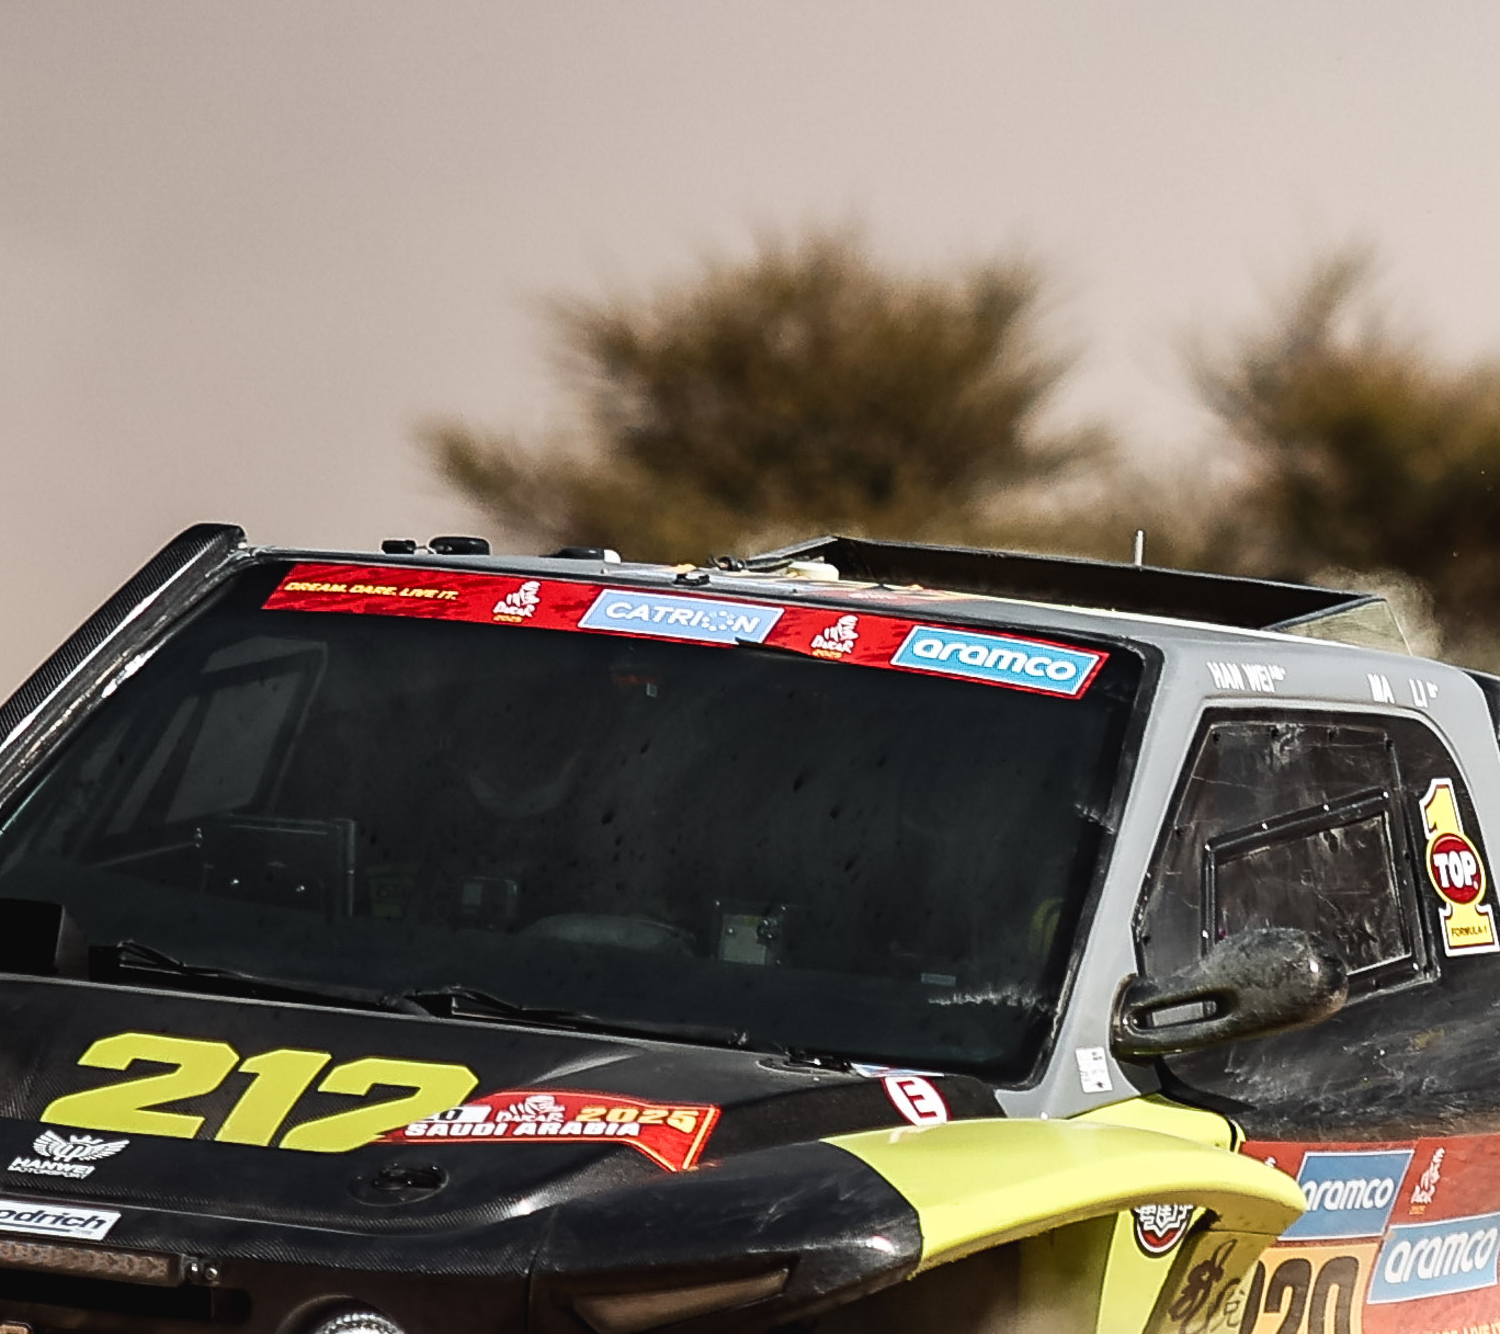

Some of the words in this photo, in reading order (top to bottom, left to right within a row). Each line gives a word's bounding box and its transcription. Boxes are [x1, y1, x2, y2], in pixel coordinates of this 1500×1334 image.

[911, 638, 1078, 681] aramco
[1206, 661, 1245, 690] HAN
[1241, 663, 1276, 693] WEI
[1367, 673, 1396, 704] MA
[1408, 678, 1429, 709] LI
[40, 1032, 479, 1154] 212
[404, 1121, 508, 1137] SAUDI
[513, 1121, 642, 1137] ARABIA
[575, 1106, 700, 1134] 2025
[1303, 1177, 1395, 1212] aramco
[1383, 1227, 1498, 1284] aramco
